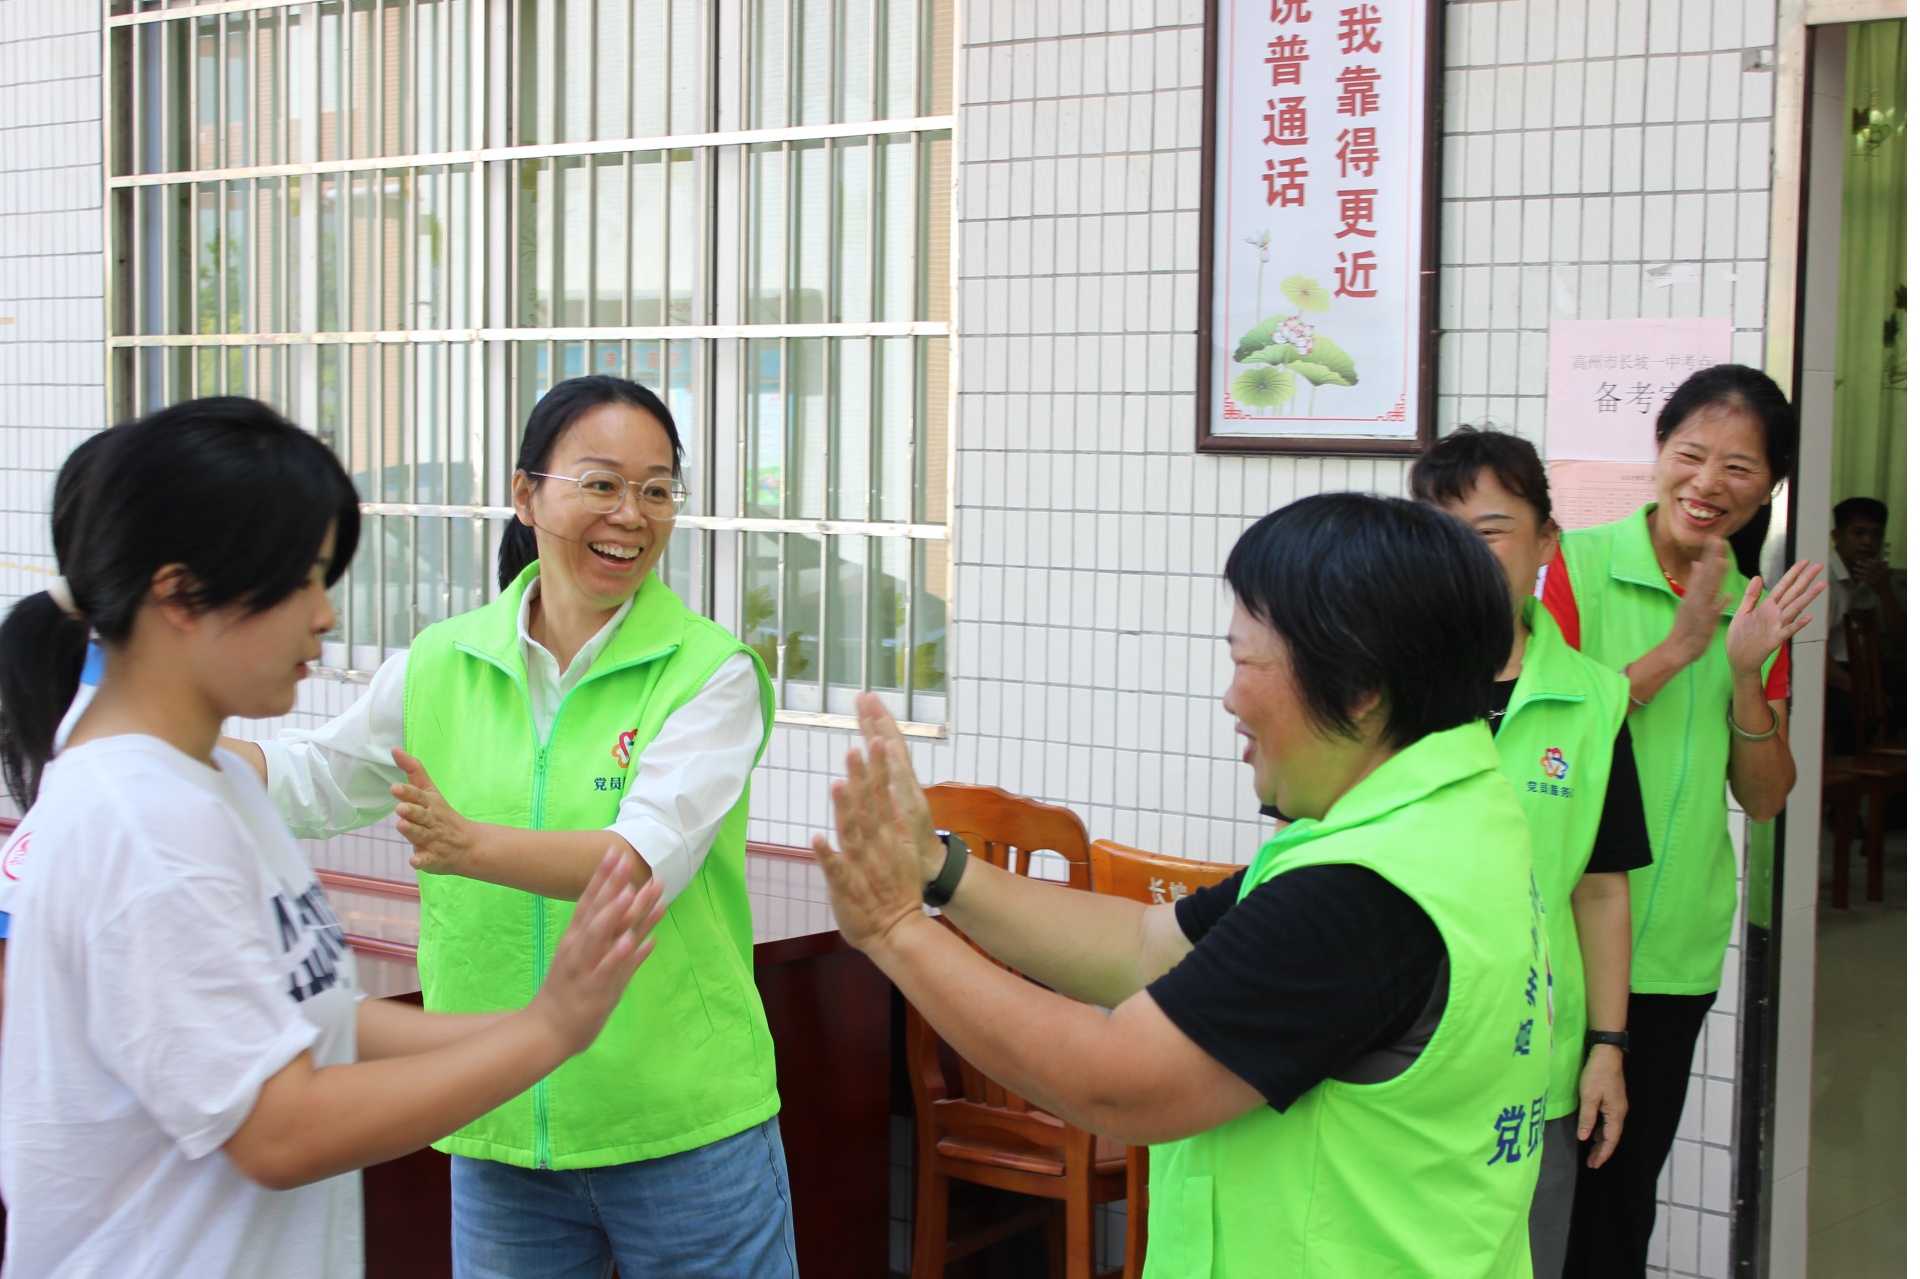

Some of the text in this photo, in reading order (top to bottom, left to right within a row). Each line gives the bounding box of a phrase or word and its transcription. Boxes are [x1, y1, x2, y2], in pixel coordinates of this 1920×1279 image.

[1333, 3, 1382, 298] 我靠得更近
[1572, 354, 1712, 370] 高州市长坡一中考点
[594, 776, 626, 791] 党员
